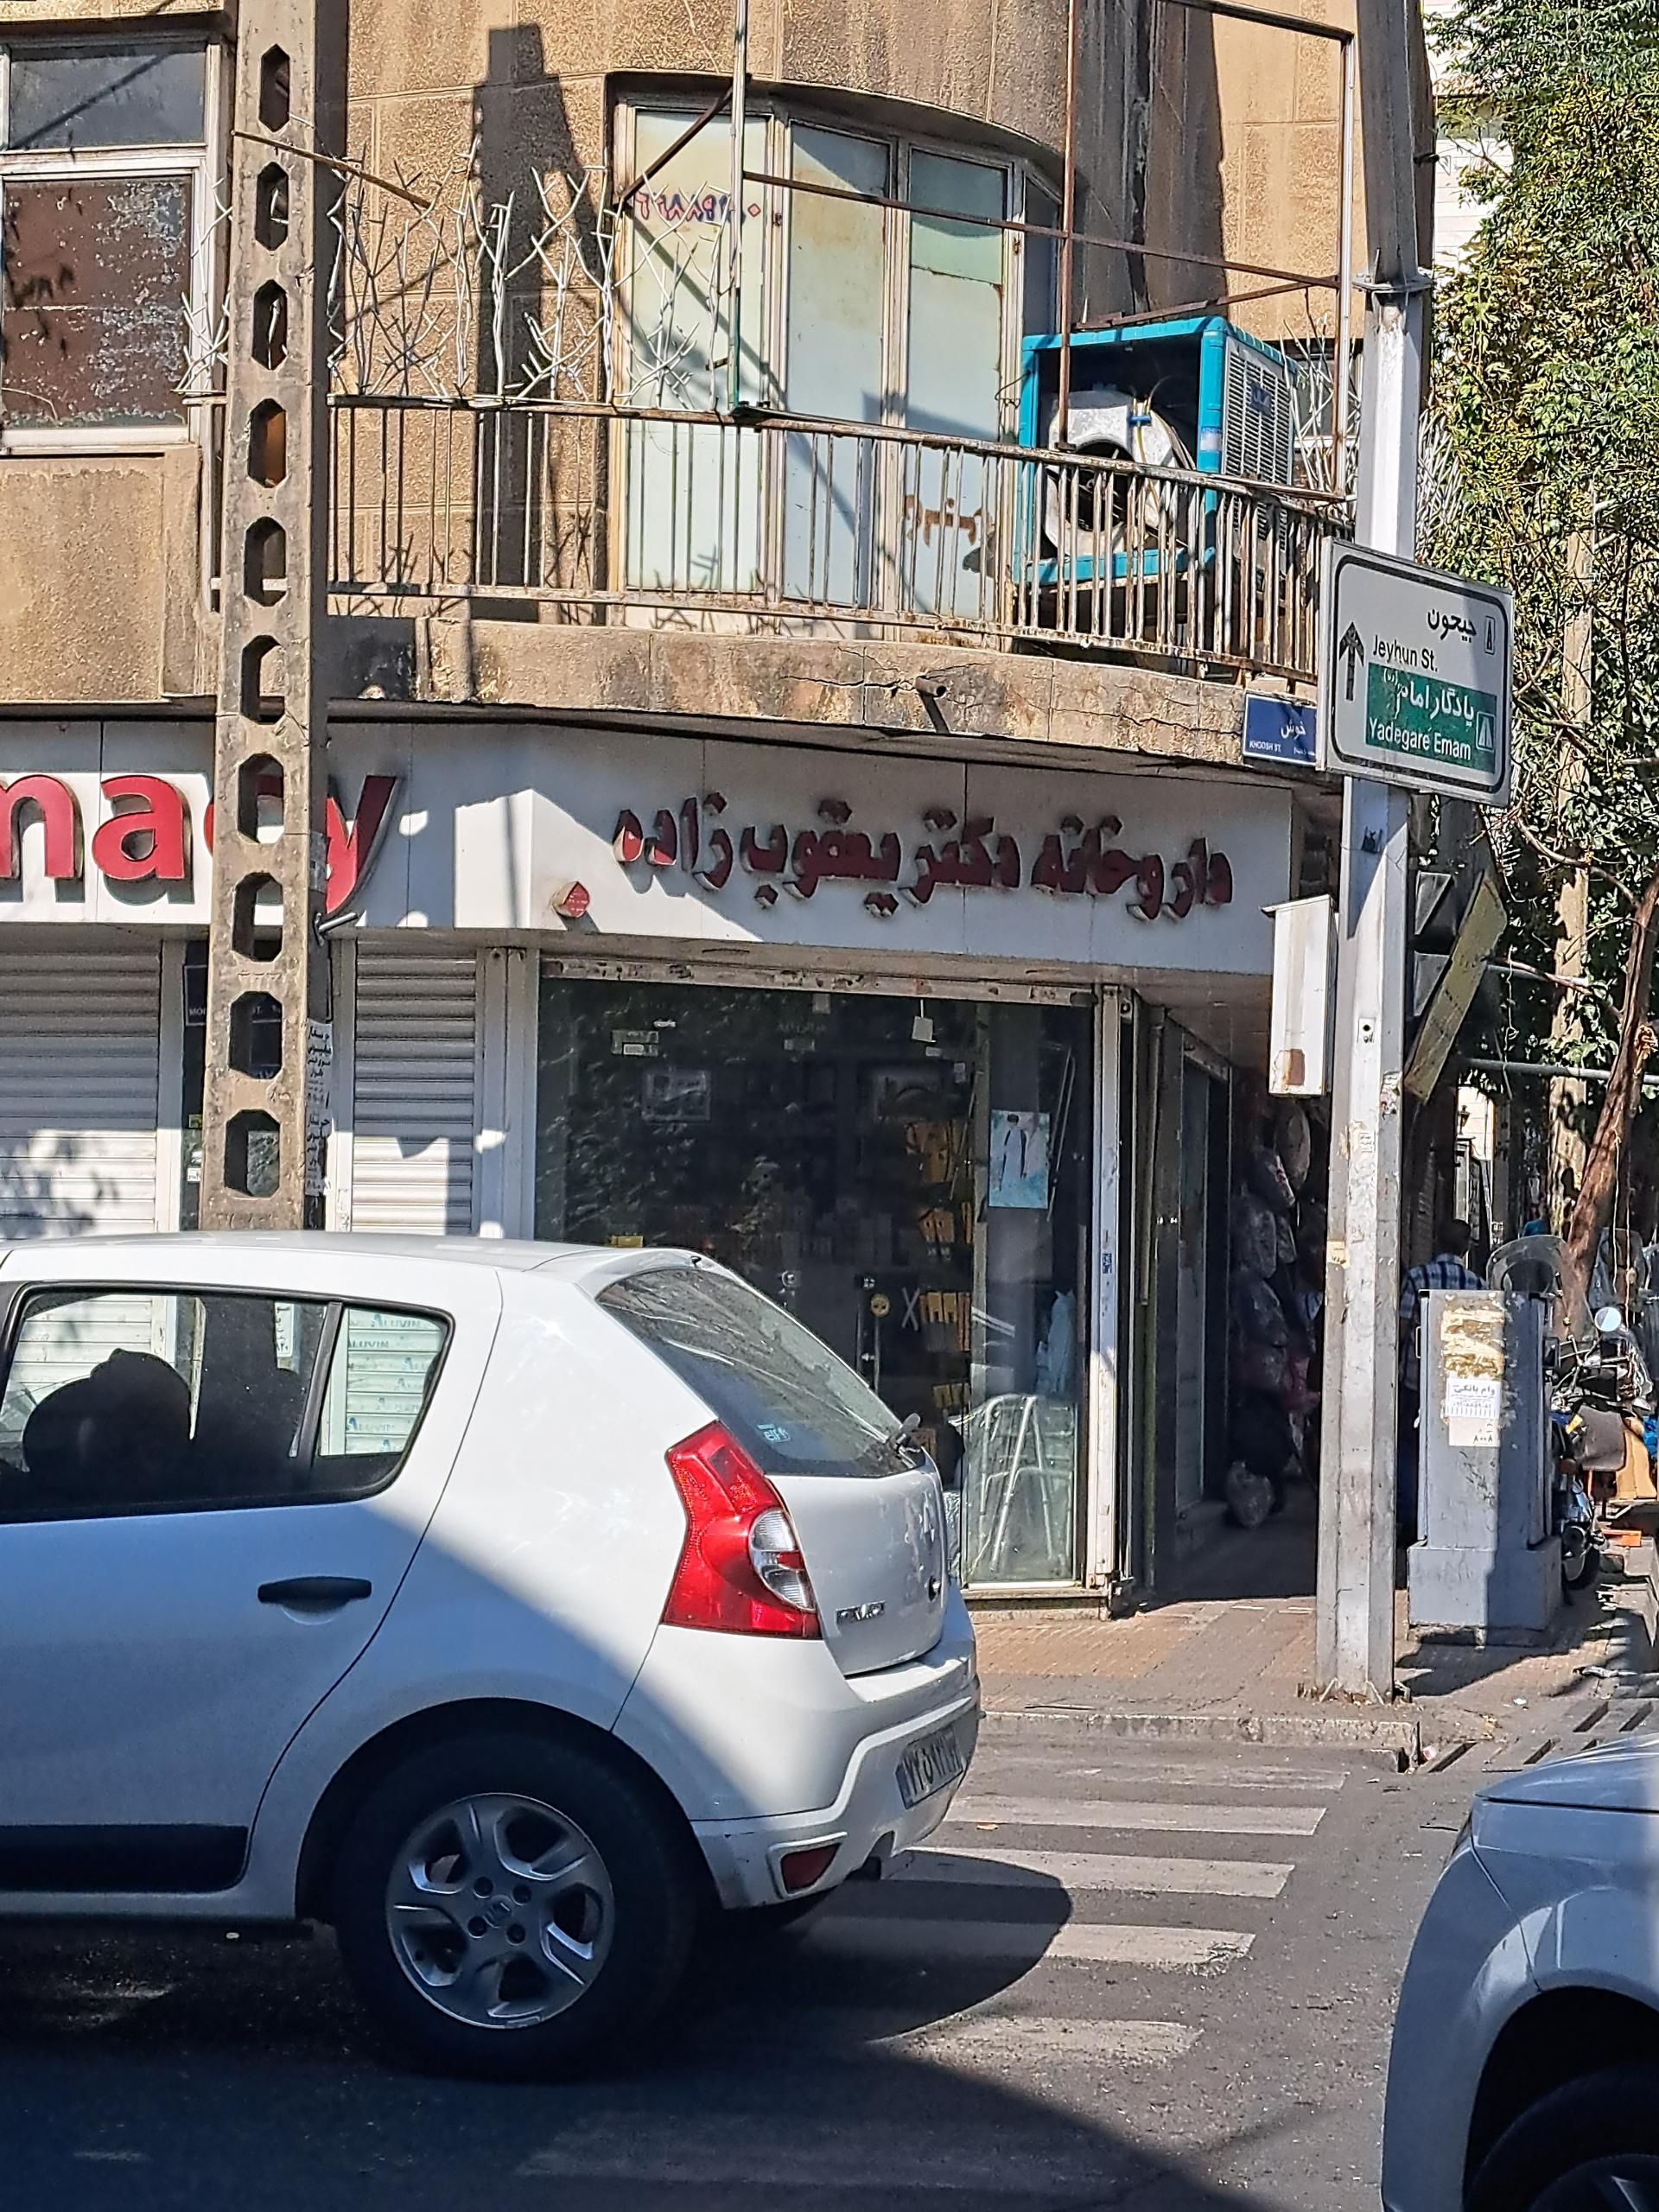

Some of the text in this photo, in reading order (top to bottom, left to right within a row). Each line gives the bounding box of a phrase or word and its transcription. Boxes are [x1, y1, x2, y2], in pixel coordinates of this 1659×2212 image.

[1427, 608, 1477, 643] جیحون
[1373, 634, 1439, 672] Jeyhun St.
[1395, 679, 1430, 719] امام
[1430, 687, 1474, 728] یادگار
[1281, 718, 1306, 740] خوش
[1434, 732, 1471, 760] Emam
[0, 774, 398, 916] may
[899, 806, 1020, 906] دکتر
[1032, 814, 1233, 921] داروخانه
[1481, 1385, 1495, 1395] وام
